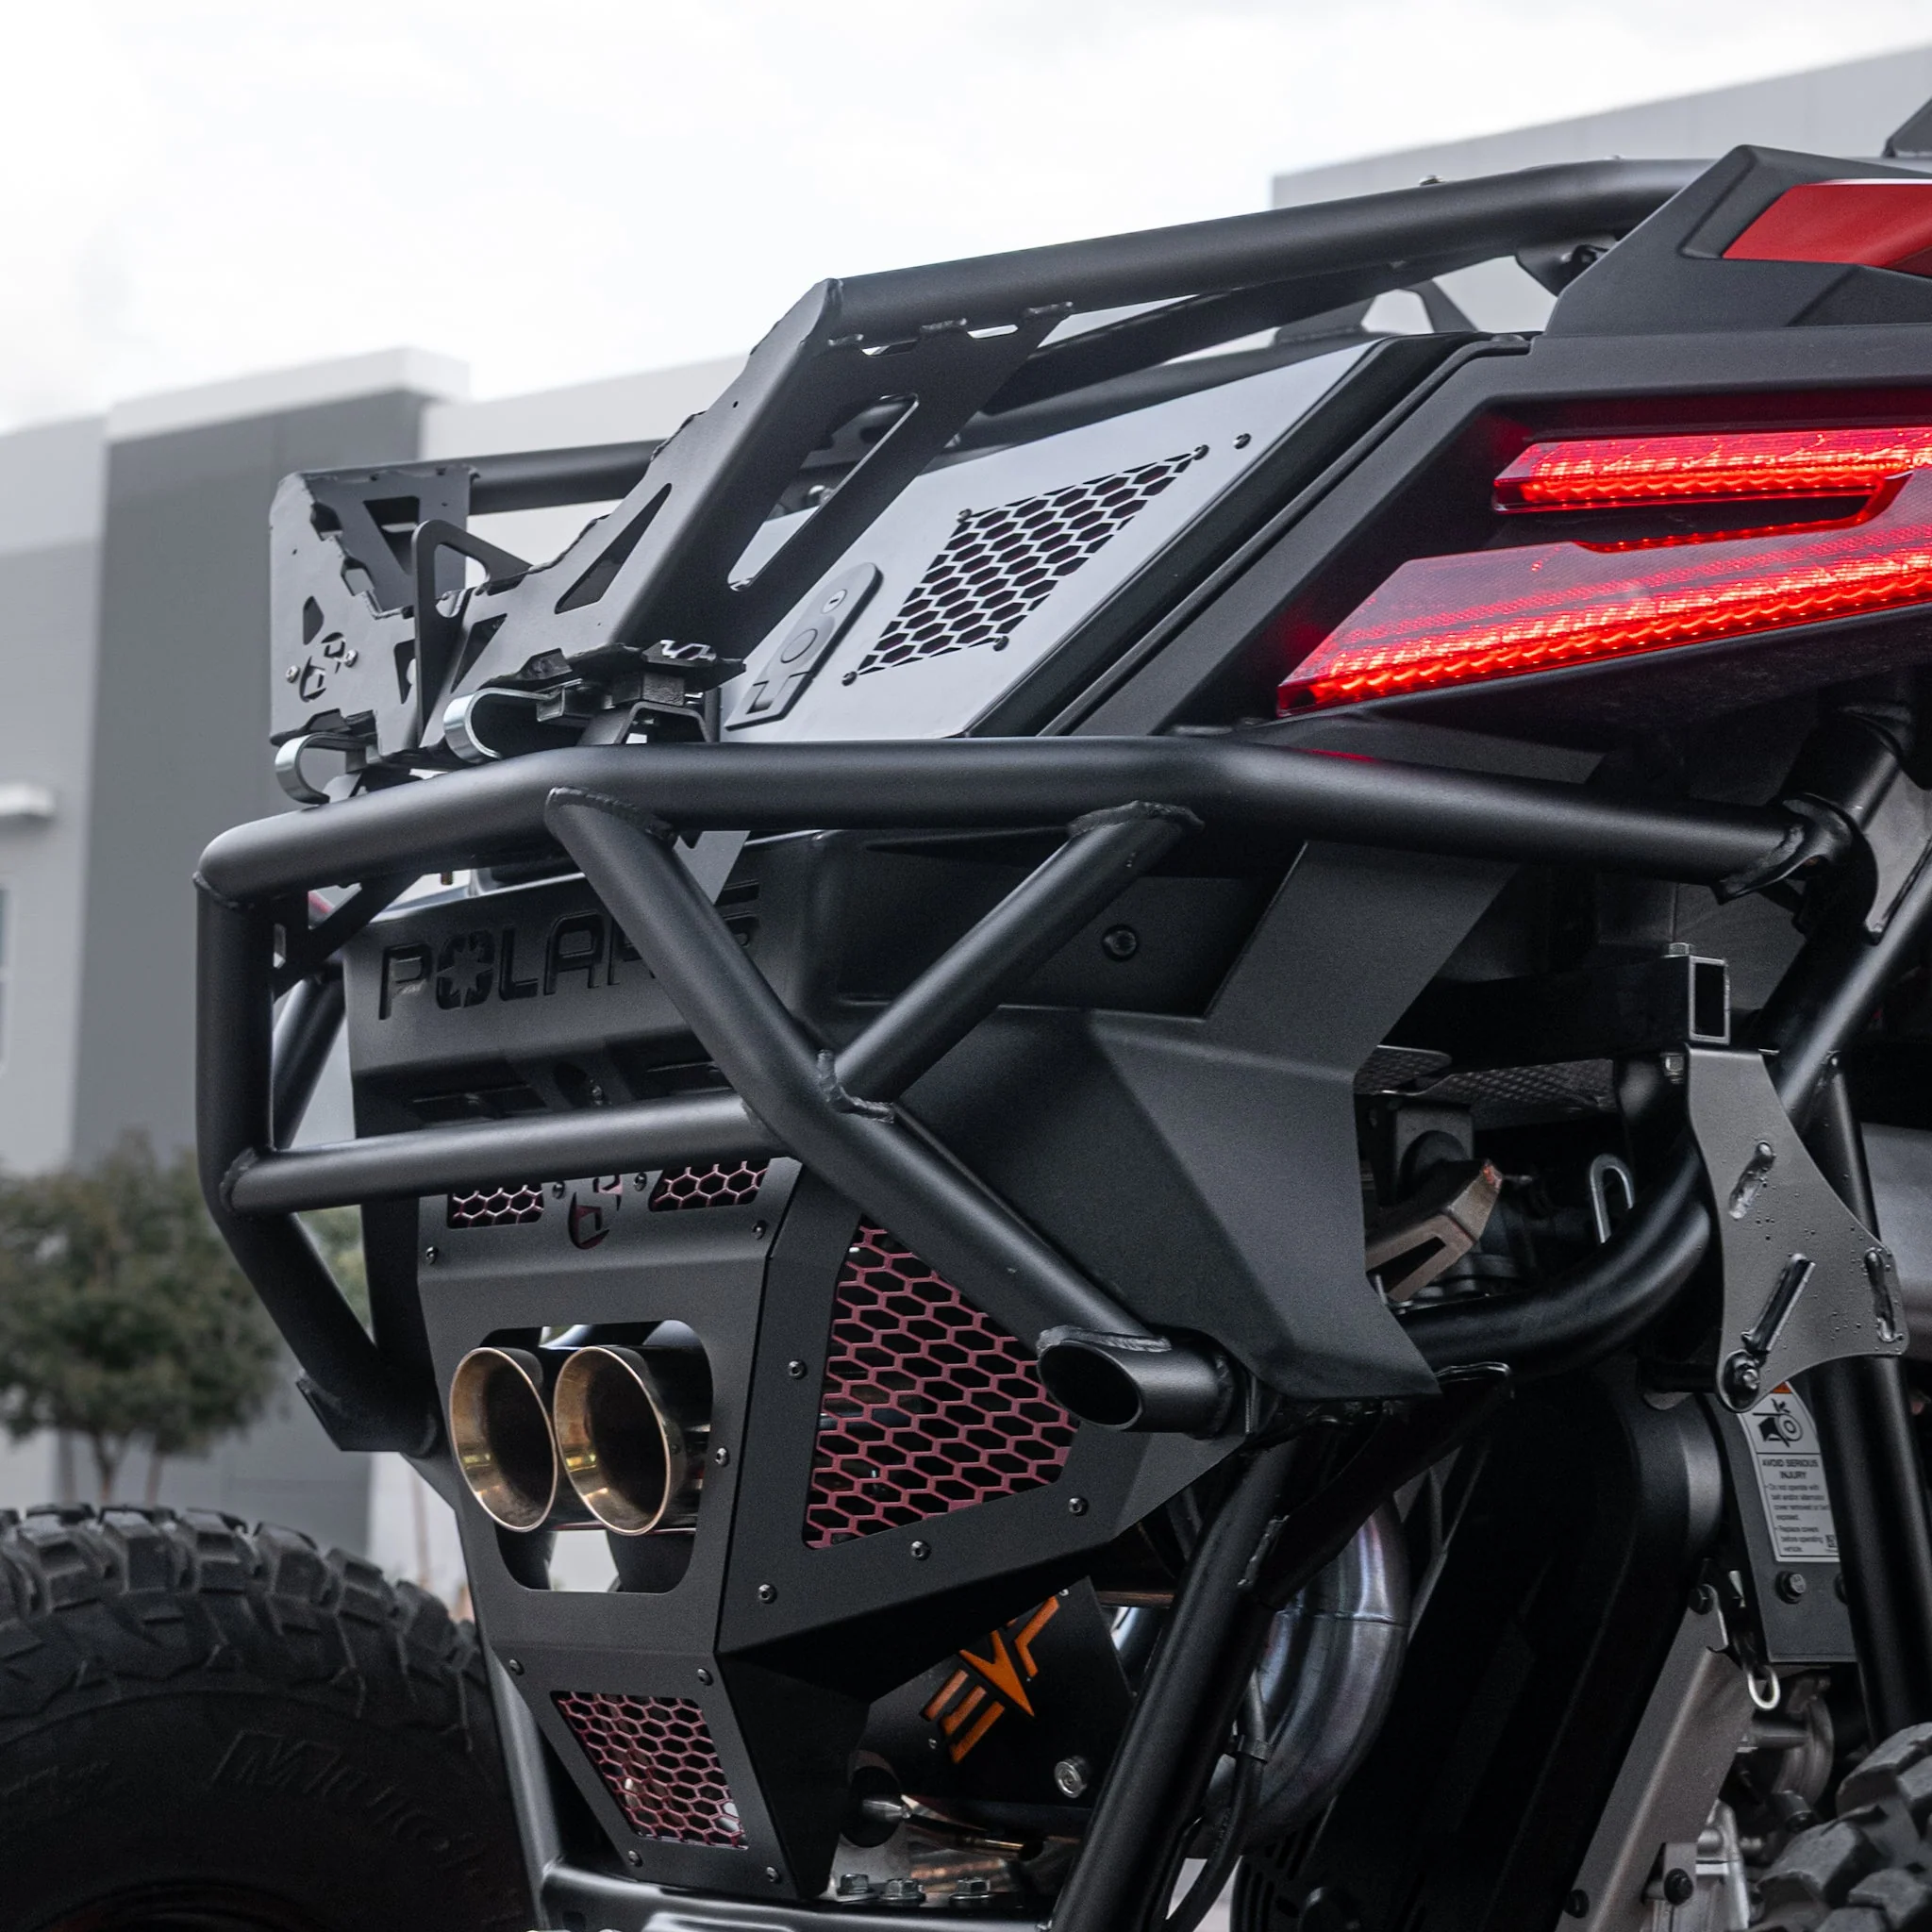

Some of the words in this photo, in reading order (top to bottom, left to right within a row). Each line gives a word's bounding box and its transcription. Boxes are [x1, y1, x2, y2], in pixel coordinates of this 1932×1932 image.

[378, 910, 759, 1020] POLA
[1761, 1458, 1784, 1468] AVOID
[1786, 1458, 1819, 1468] SERIOUS
[1779, 1470, 1807, 1480] INJURY
